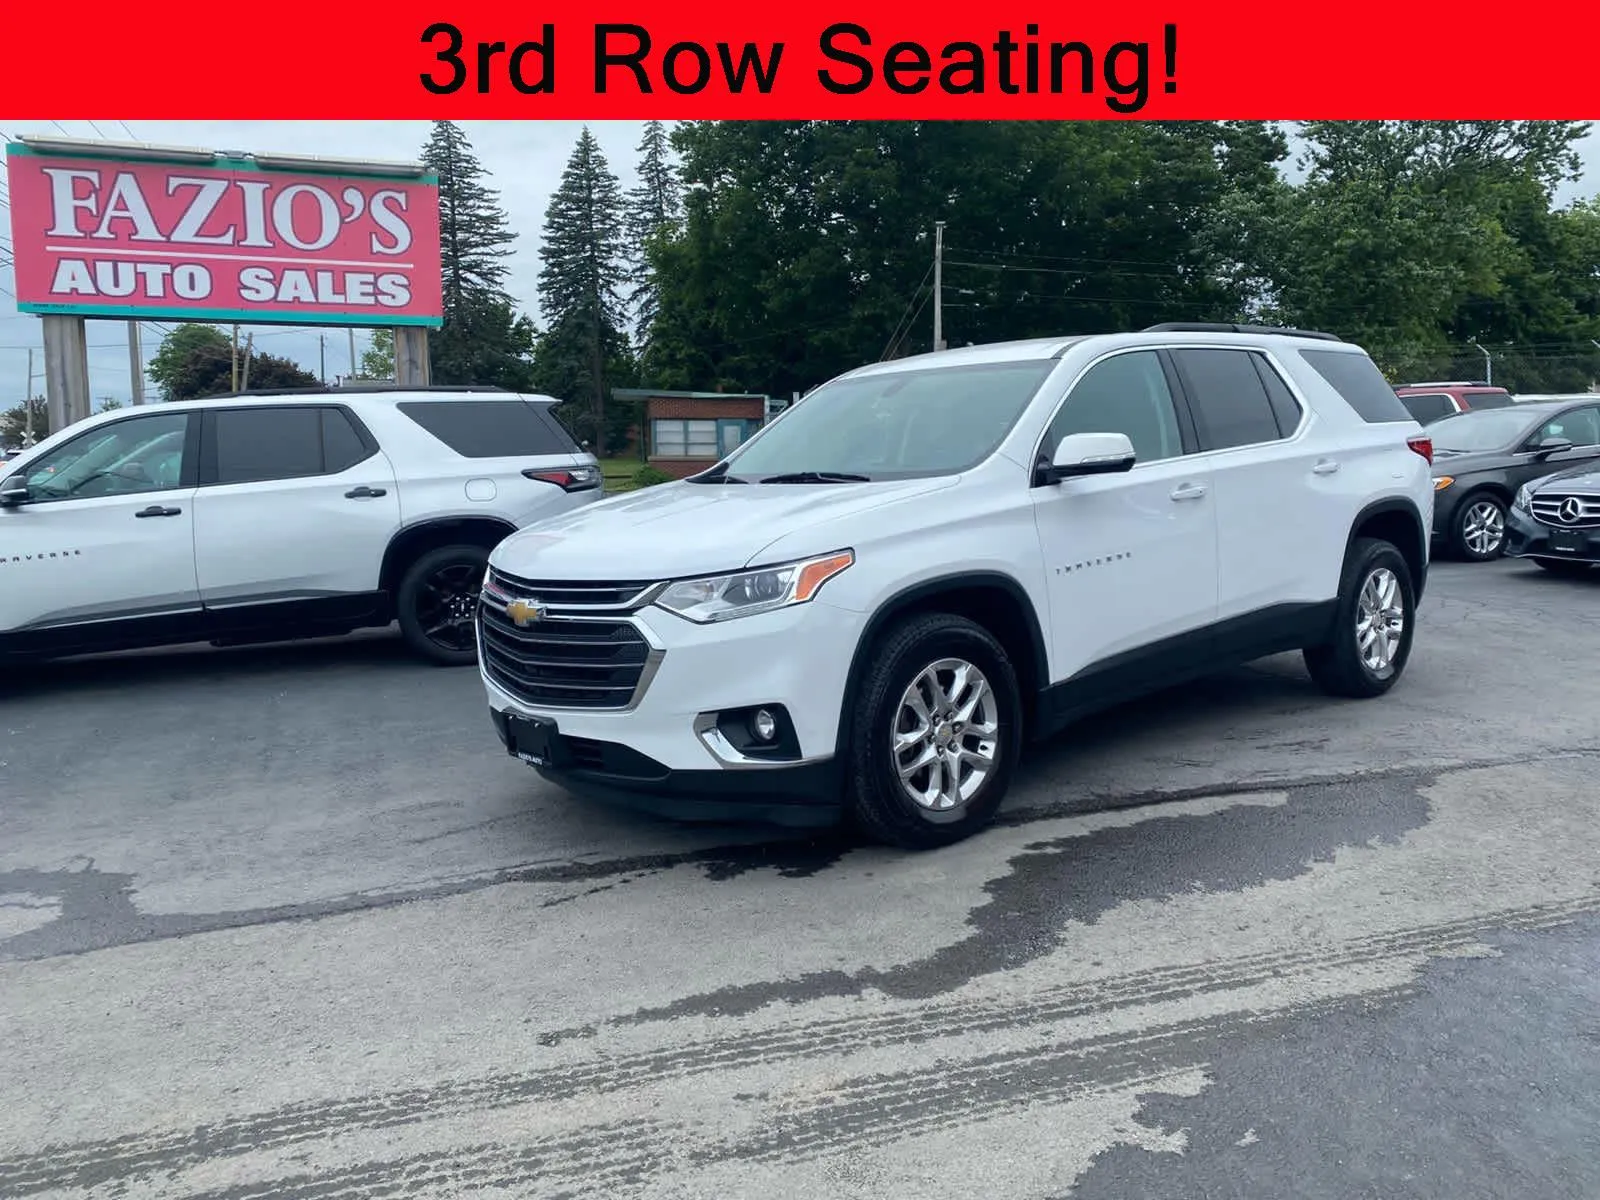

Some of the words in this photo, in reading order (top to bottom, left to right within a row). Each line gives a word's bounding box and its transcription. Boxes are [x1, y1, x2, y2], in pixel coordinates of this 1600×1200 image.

[43, 167, 414, 255] FAZIO'S
[50, 258, 212, 299] AUTO
[239, 265, 412, 306] SALES
